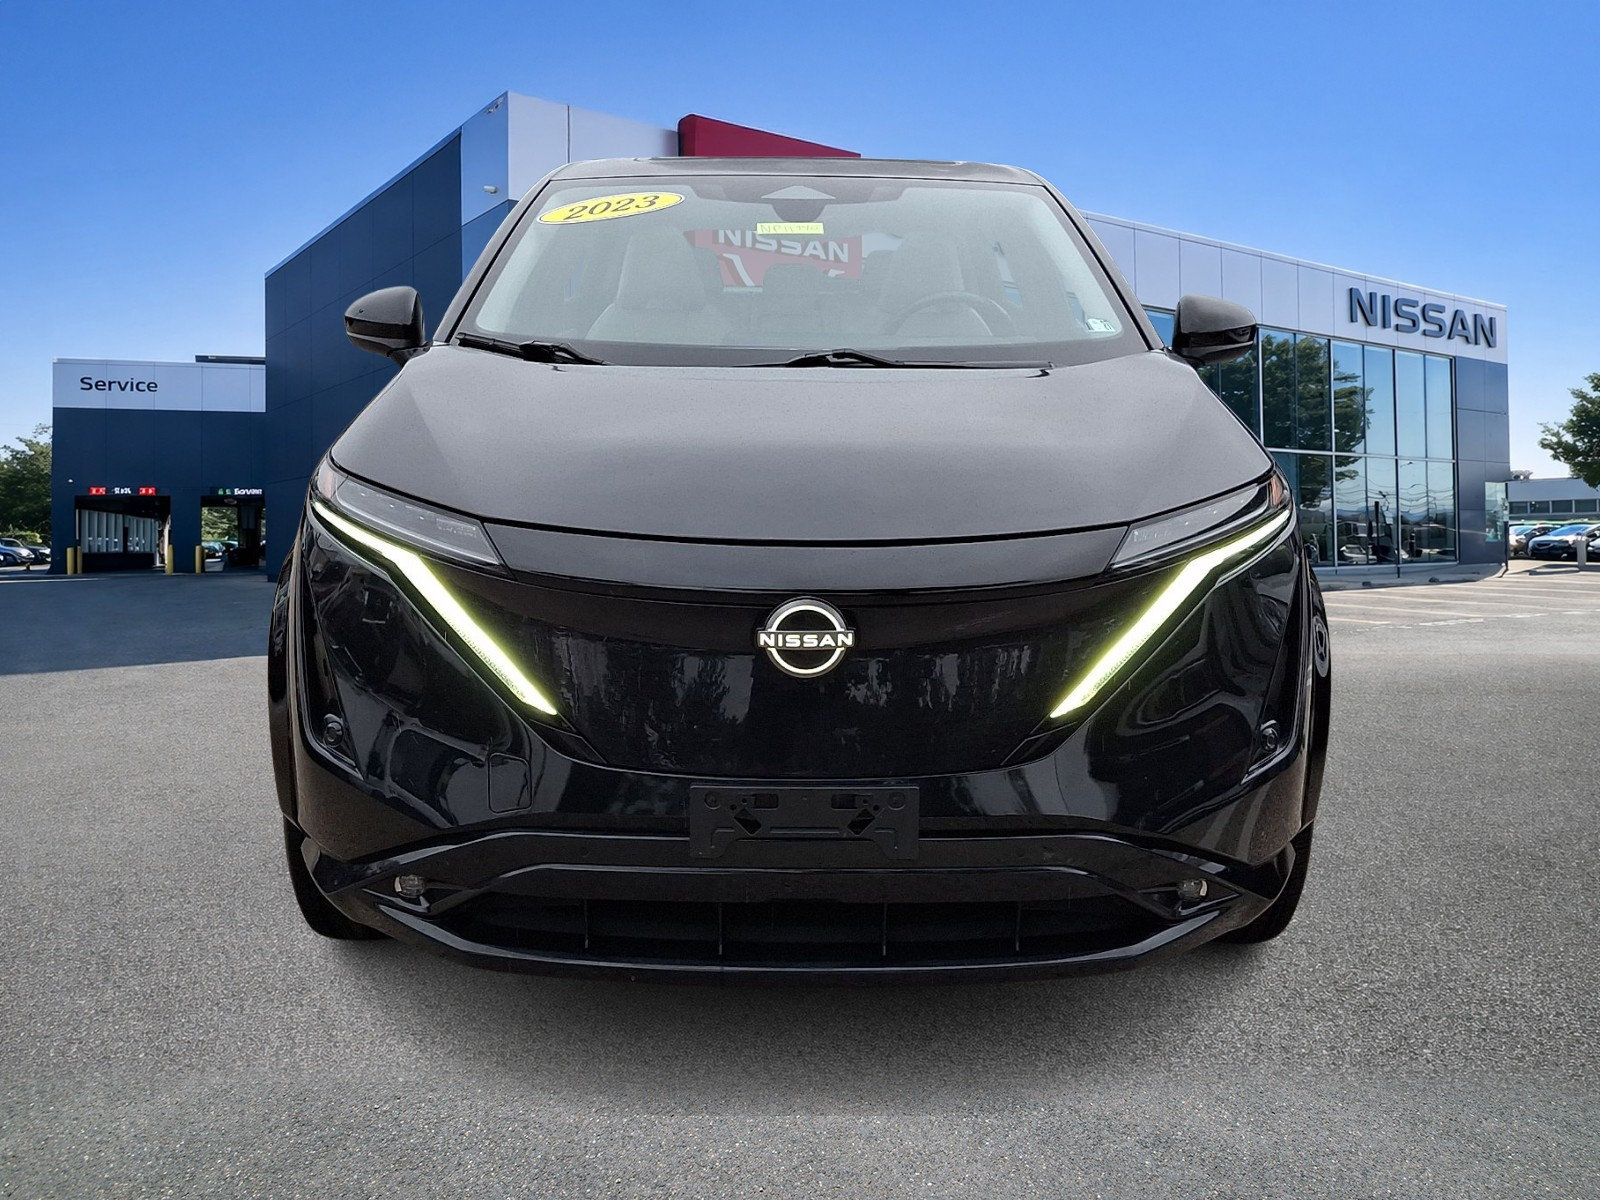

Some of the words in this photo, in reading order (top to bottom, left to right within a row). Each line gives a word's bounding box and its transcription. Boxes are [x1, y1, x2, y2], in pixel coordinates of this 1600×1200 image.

[563, 195, 660, 220] 2023
[1349, 287, 1497, 348] NISSAN
[80, 376, 158, 393] Service
[759, 633, 853, 648] NISSAN
